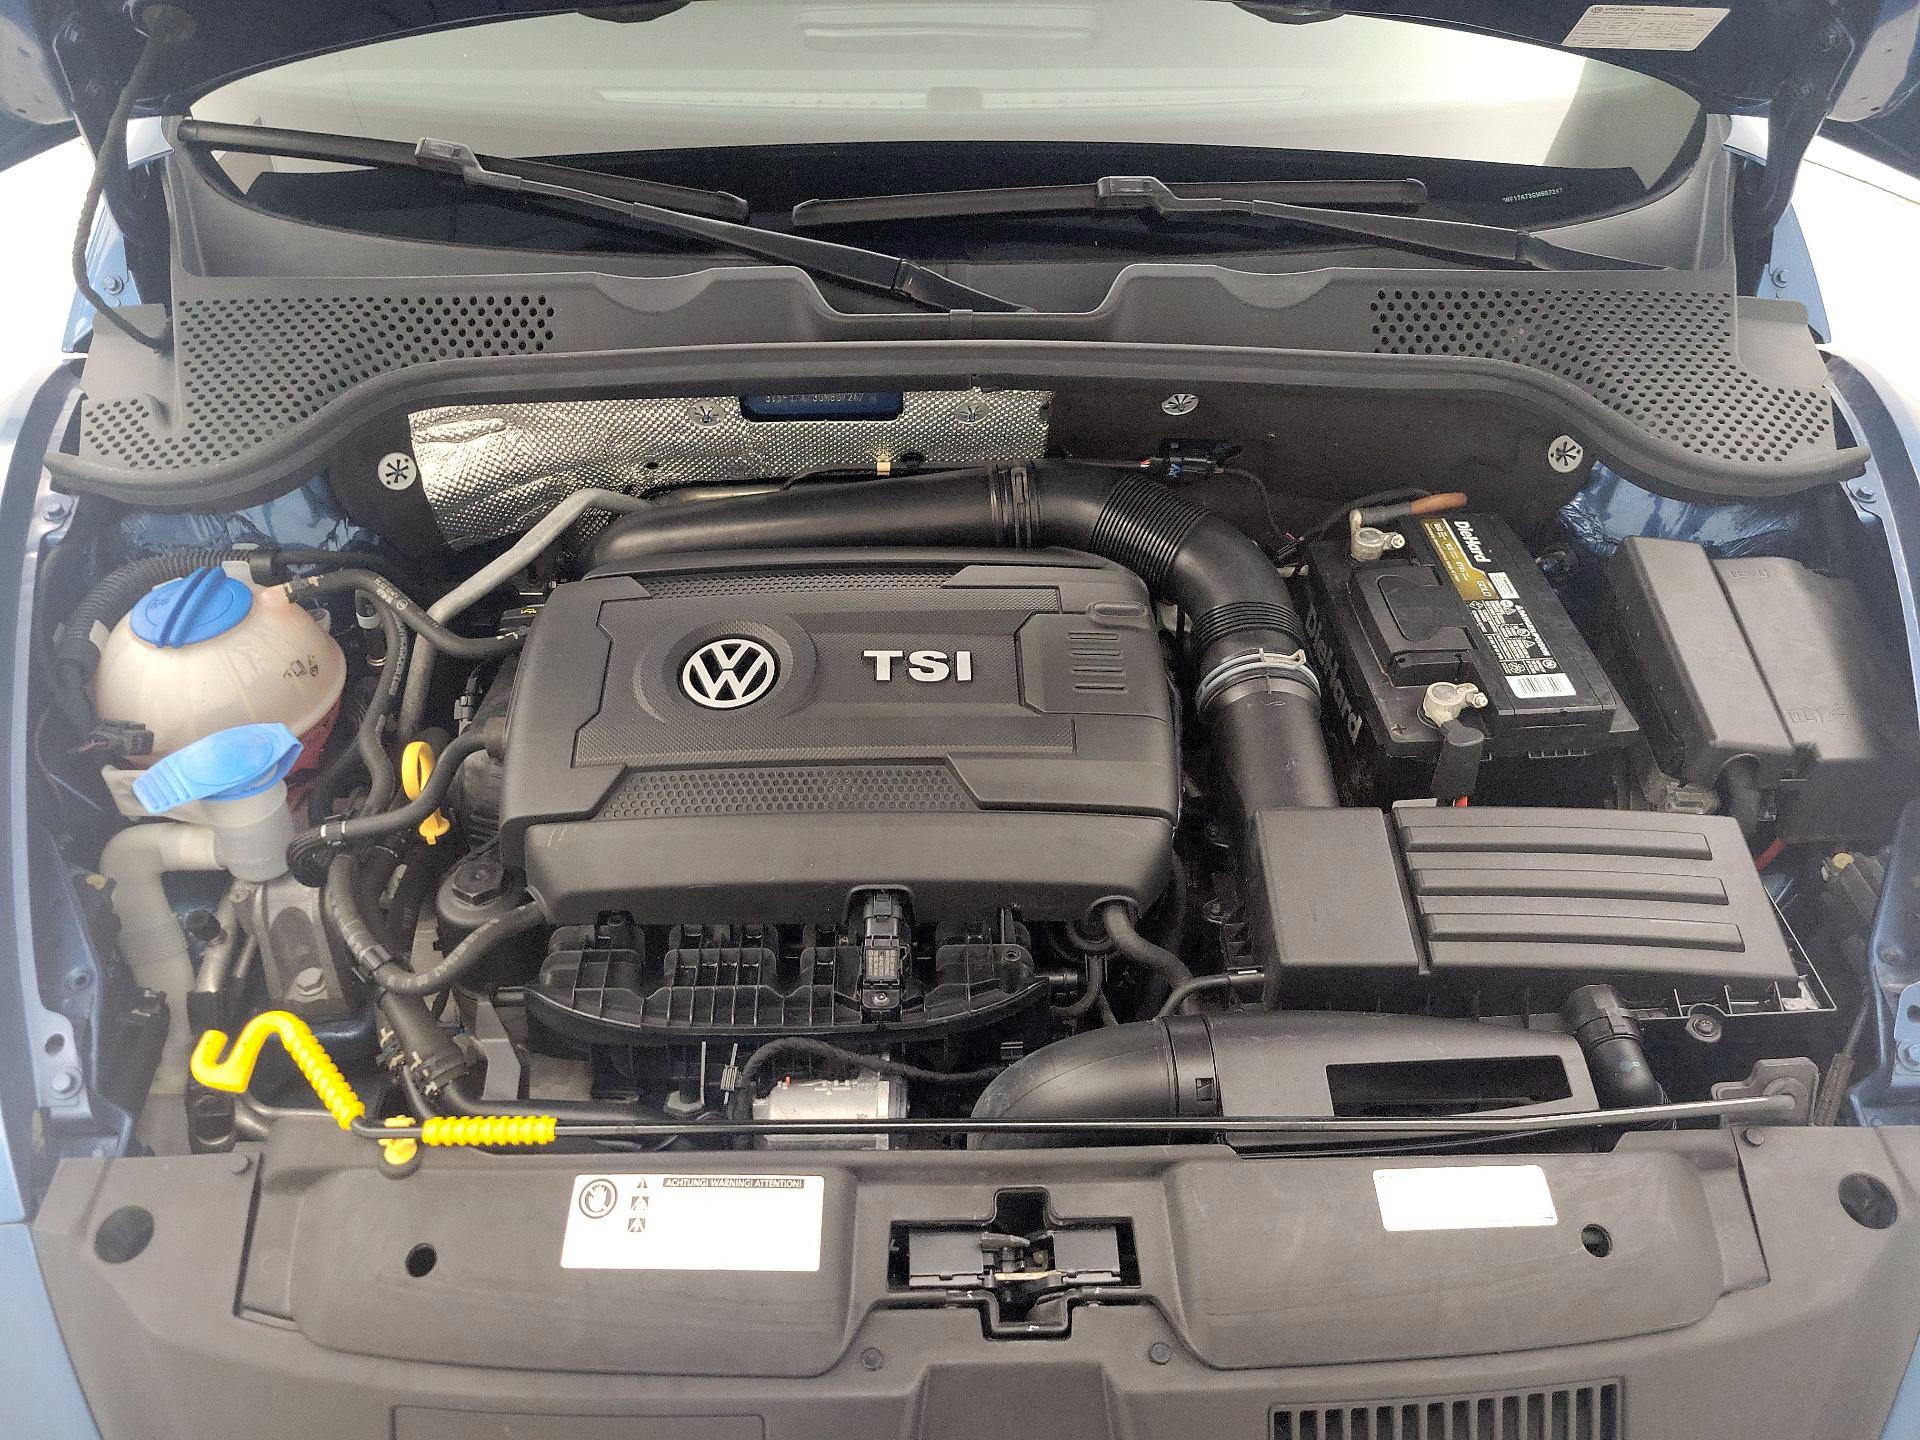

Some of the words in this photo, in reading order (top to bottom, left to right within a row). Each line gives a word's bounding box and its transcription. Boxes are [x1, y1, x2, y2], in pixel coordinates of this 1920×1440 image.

[1454, 521, 1492, 562] DieHard
[684, 639, 774, 707] VW
[863, 650, 973, 682] TSI
